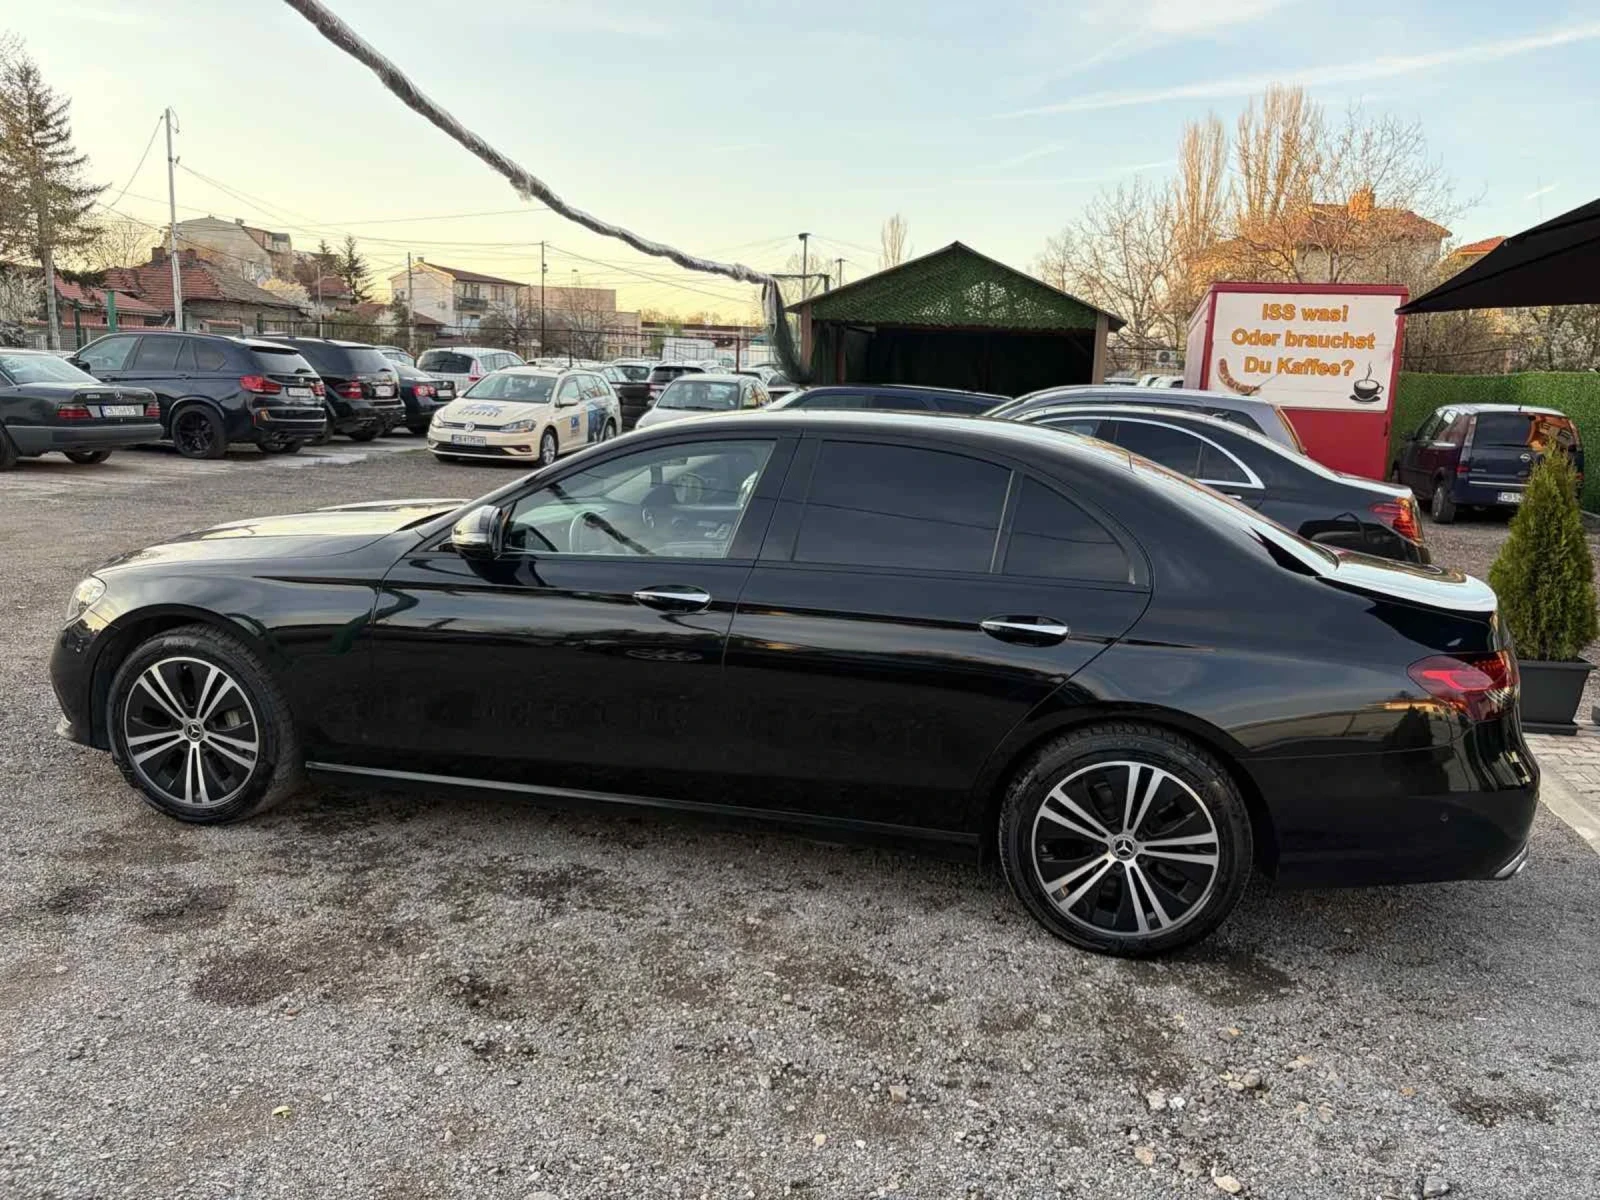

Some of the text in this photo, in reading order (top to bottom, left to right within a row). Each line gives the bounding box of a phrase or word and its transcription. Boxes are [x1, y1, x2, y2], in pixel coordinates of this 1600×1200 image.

[1262, 303, 1349, 322] ISS was!
[1231, 327, 1376, 350] Oder brauchst
[1243, 356, 1355, 377] Du Kaffee?
